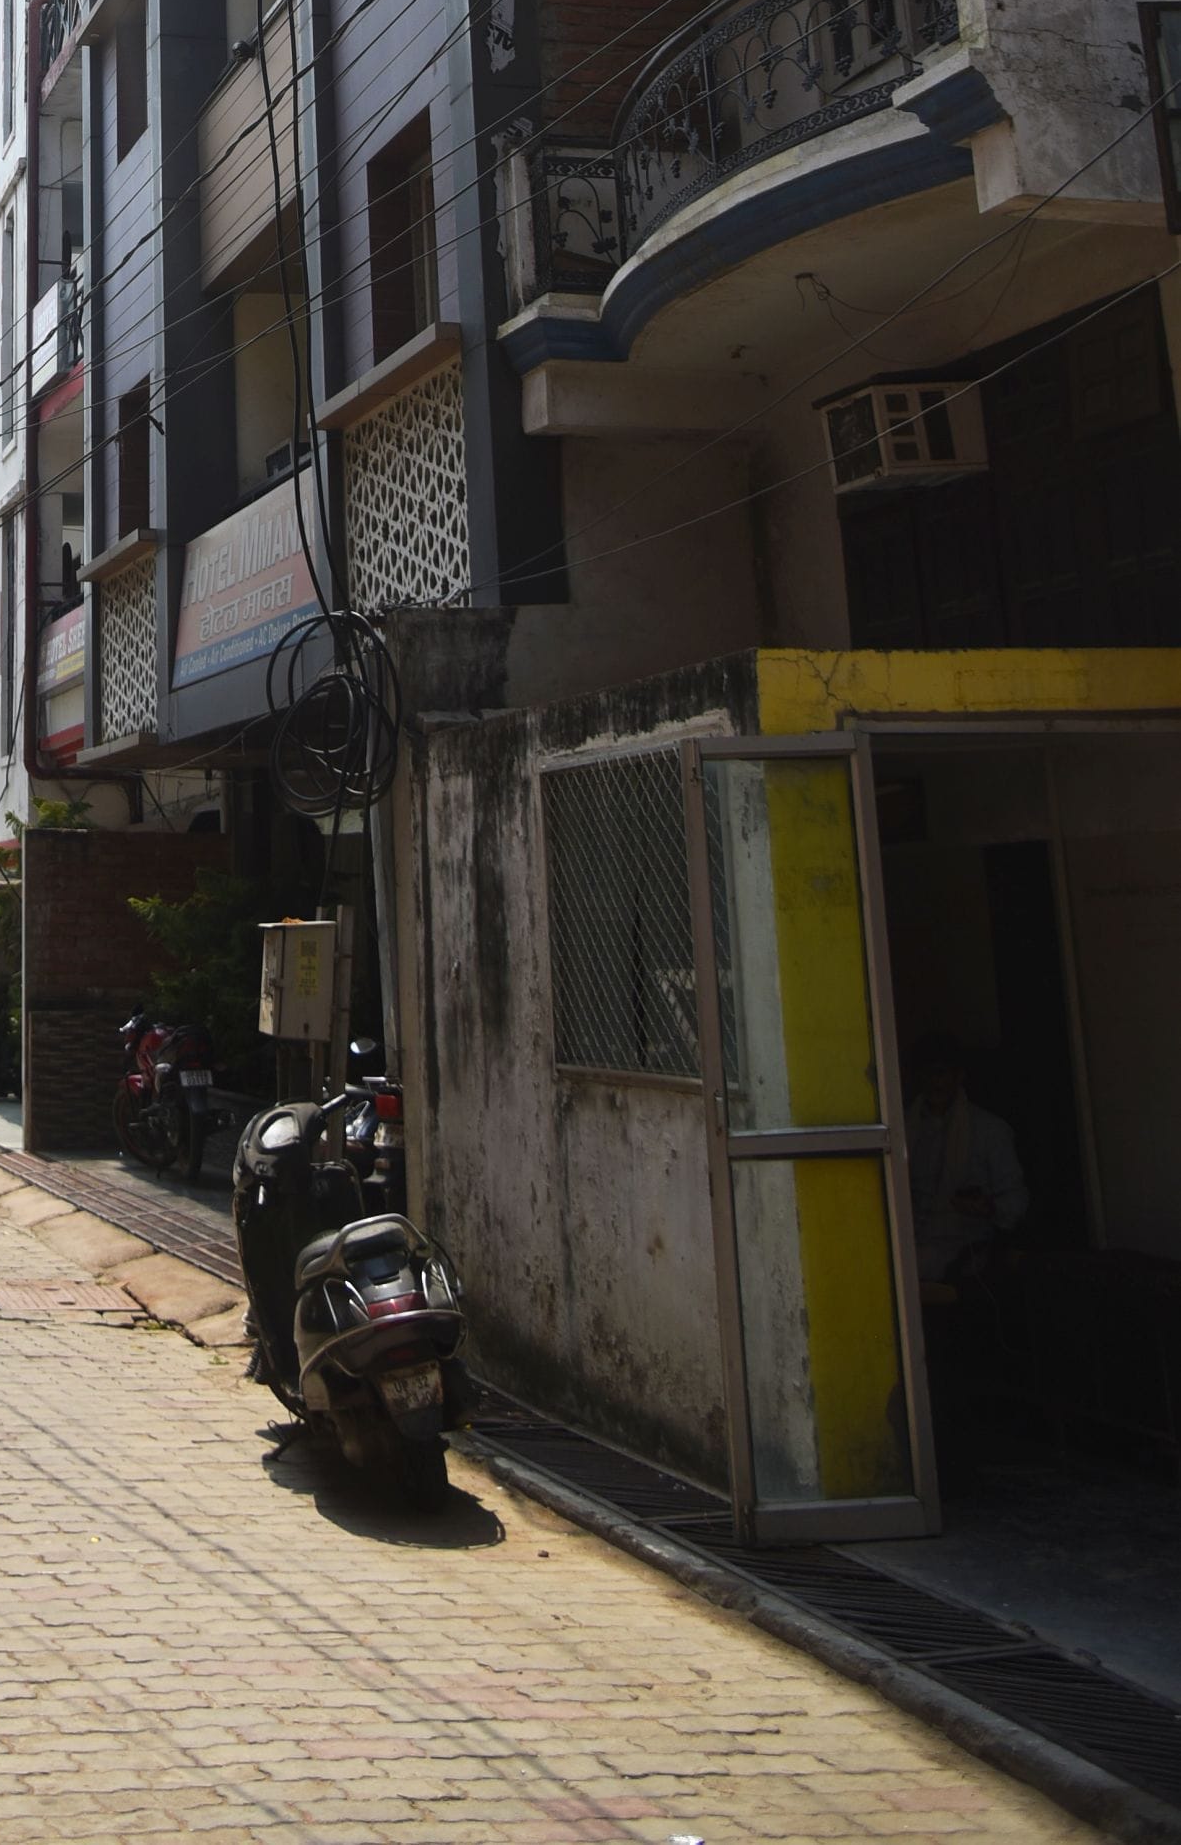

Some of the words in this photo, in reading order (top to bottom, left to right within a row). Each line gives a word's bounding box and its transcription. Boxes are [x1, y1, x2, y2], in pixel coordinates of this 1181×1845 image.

[182, 543, 236, 610] HOTEL
[199, 598, 241, 642] होटल
[242, 573, 294, 620] मानस
